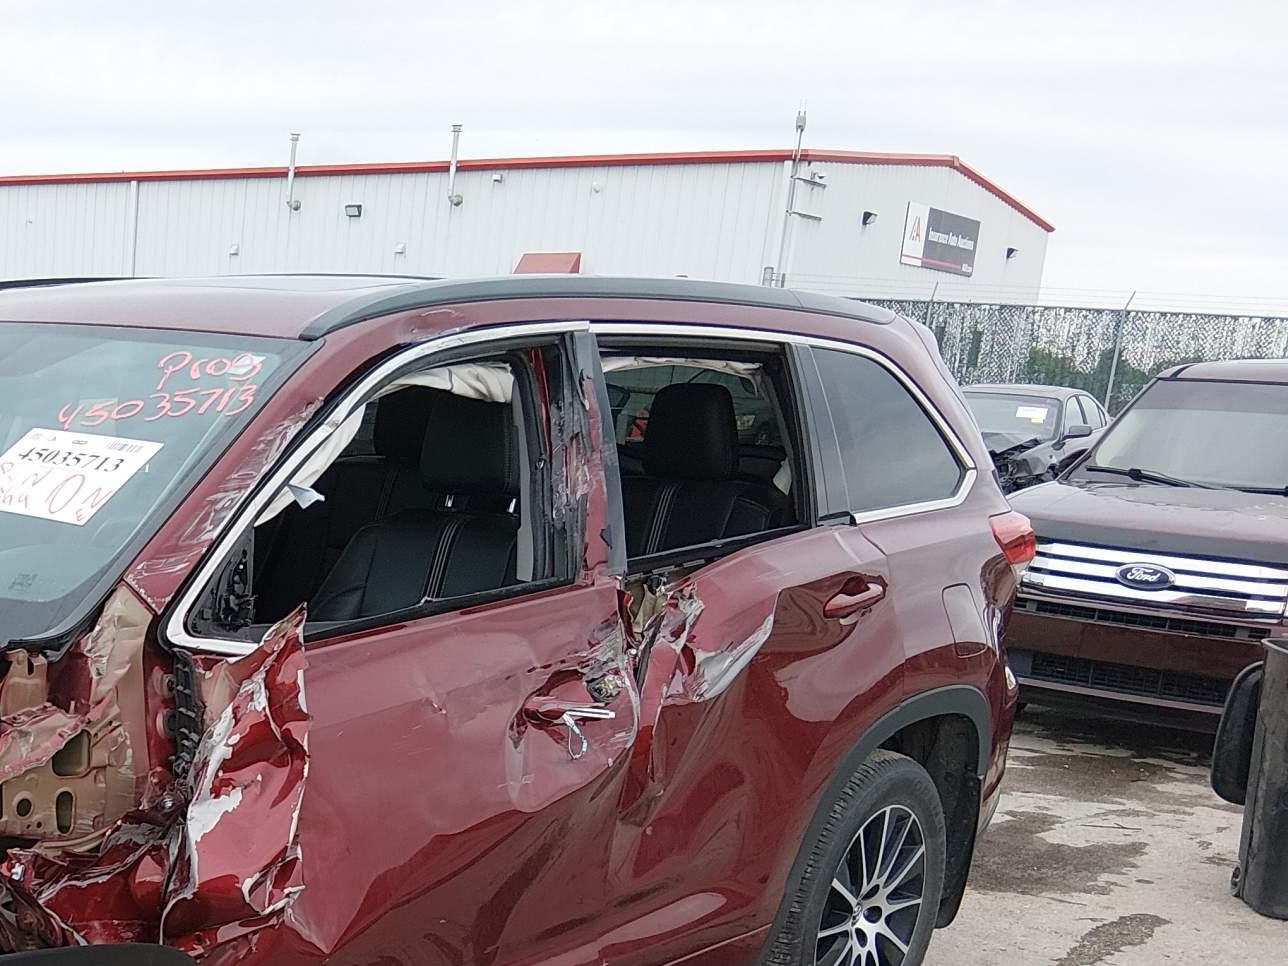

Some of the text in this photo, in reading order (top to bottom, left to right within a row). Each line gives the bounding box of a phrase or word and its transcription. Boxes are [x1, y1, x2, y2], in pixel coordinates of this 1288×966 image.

[58, 385, 257, 429] 45035713
[18, 448, 125, 472] 45035713
[1127, 567, 1161, 582] Ford
